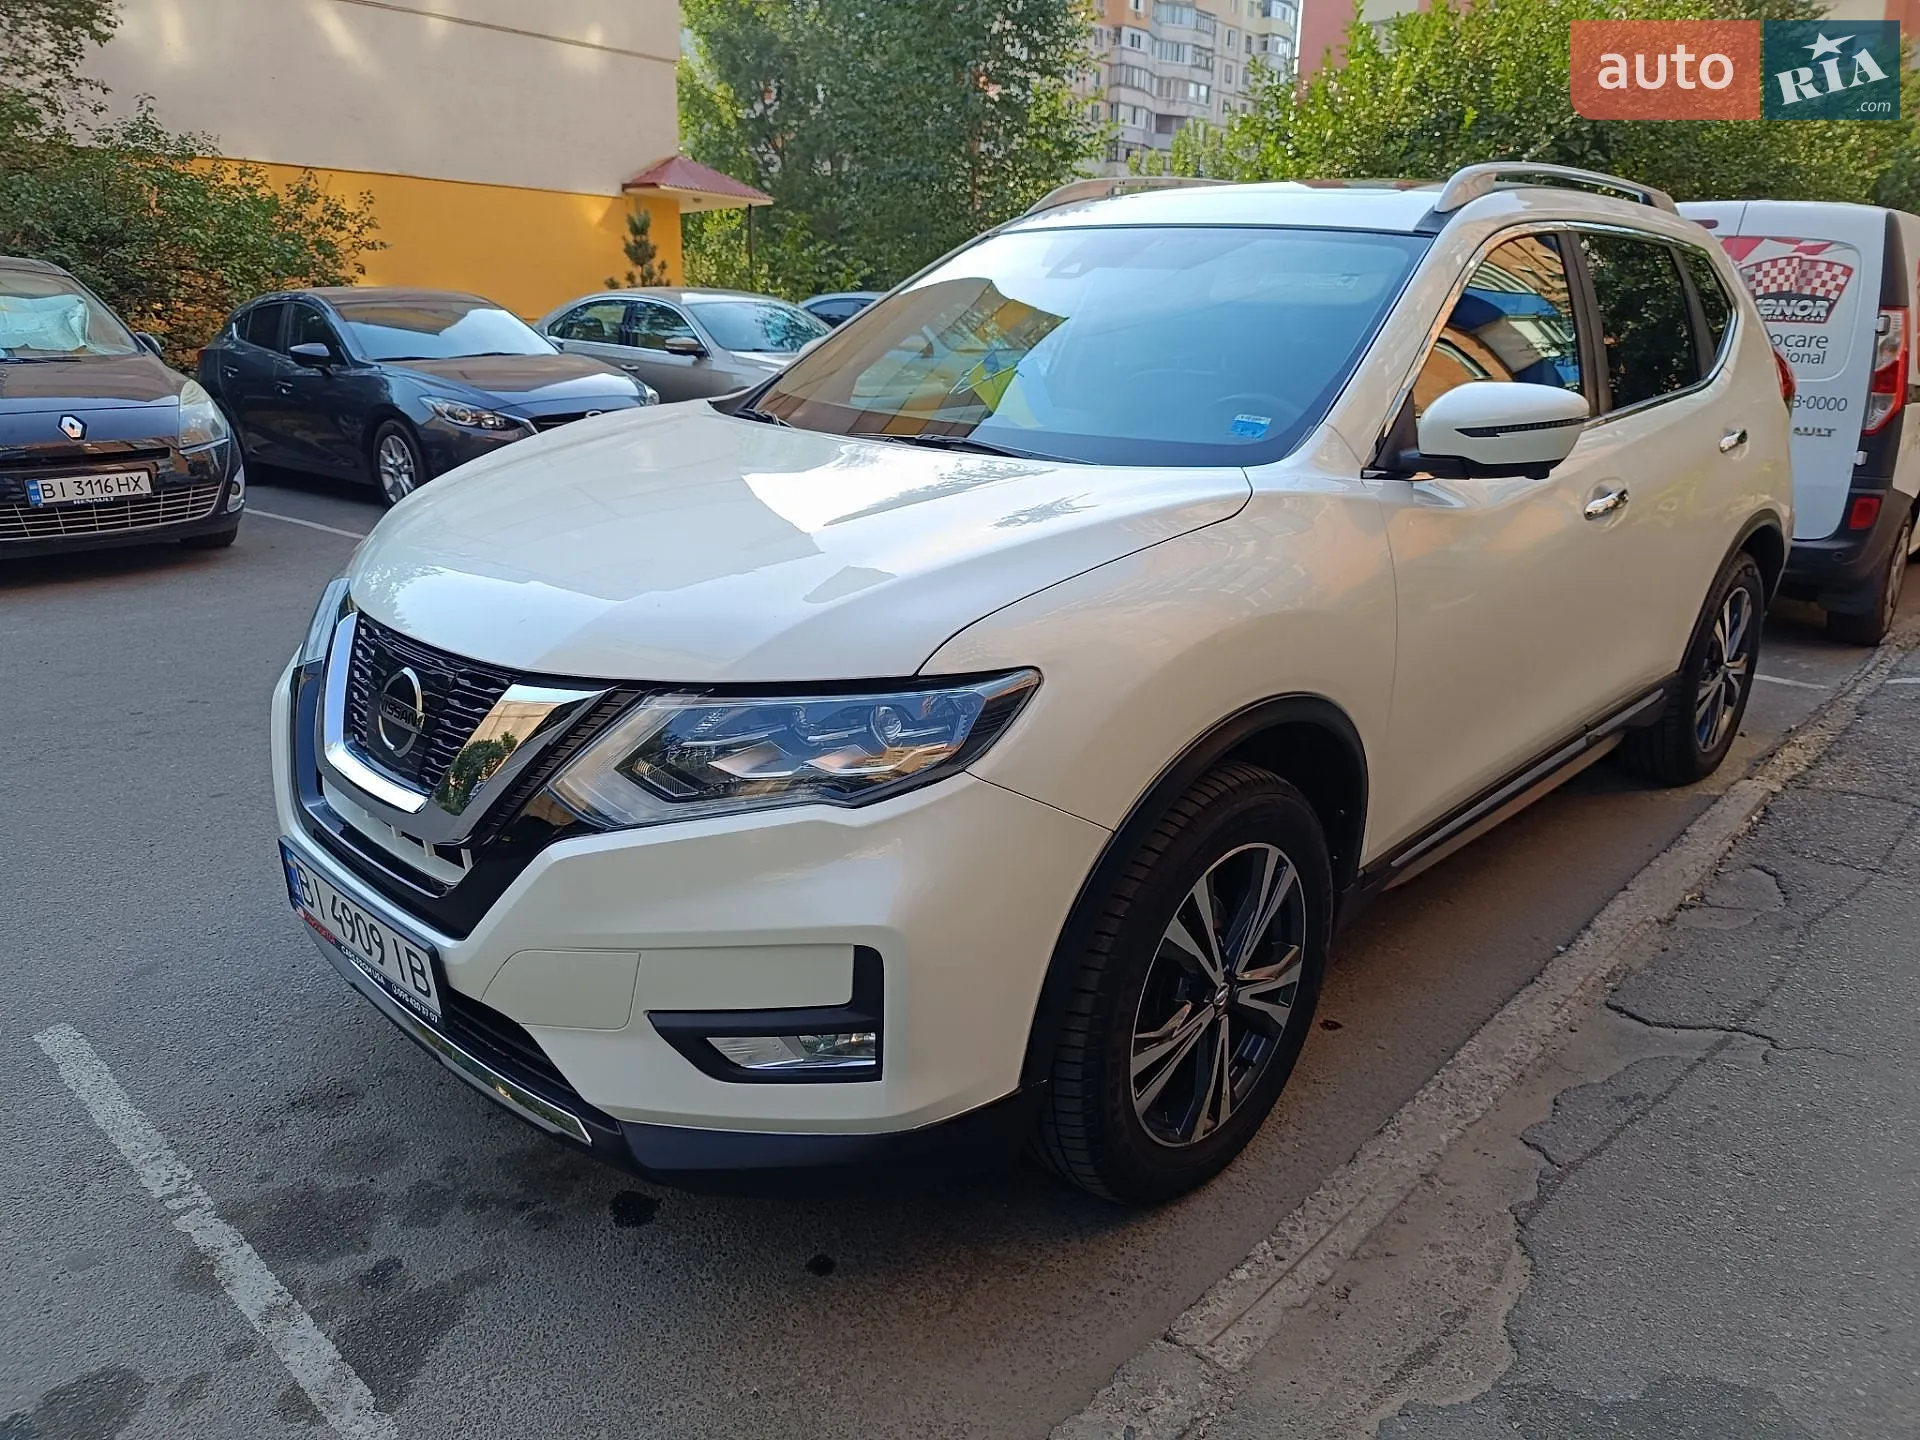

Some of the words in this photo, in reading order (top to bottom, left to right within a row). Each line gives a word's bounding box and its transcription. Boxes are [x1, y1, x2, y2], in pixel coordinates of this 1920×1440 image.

[1770, 333, 1829, 349] ocare
[1785, 349, 1826, 364] ional
[41, 482, 66, 499] BI
[73, 478, 114, 496] 3116
[115, 475, 144, 493] HX
[296, 862, 325, 920] BI
[331, 894, 385, 965] 4909
[393, 937, 431, 998] IB
